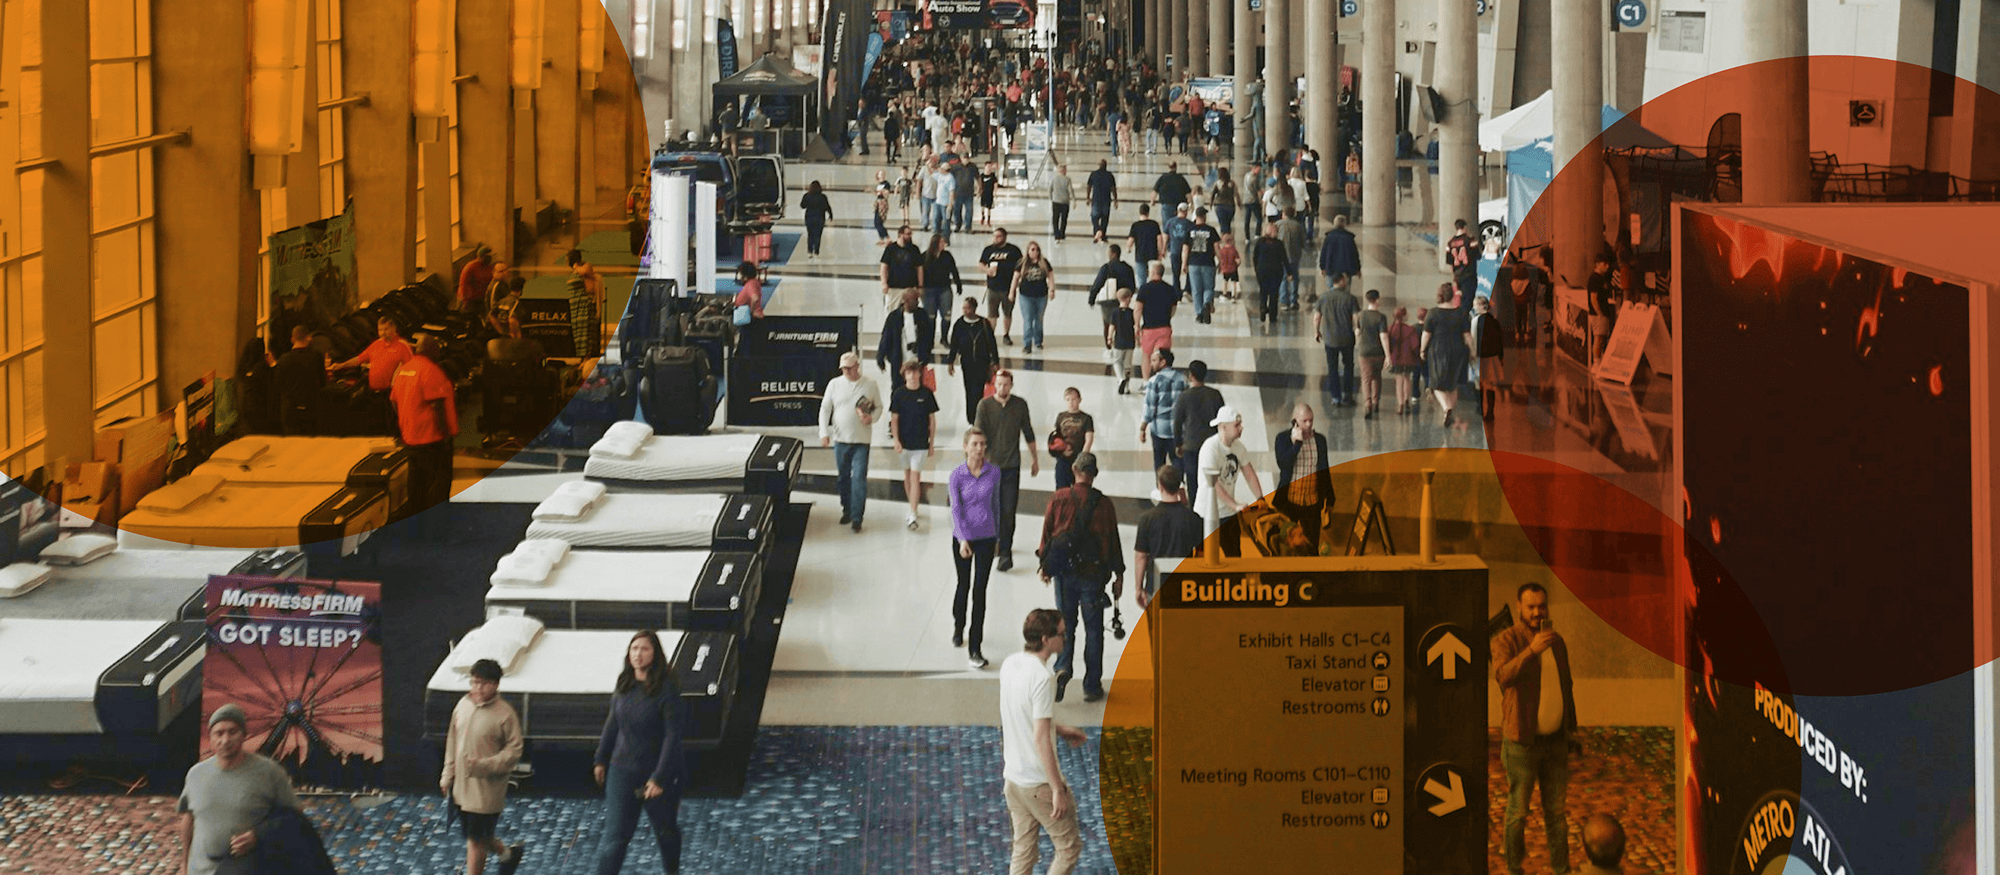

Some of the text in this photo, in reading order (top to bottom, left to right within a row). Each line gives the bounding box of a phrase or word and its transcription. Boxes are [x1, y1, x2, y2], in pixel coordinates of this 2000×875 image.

[928, 0, 981, 13] Auto Show
[1344, 3, 1355, 12] C1
[1477, 0, 1484, 13] 2
[1620, 4, 1640, 21] C1
[832, 11, 846, 63] CHEVROLET
[531, 311, 567, 321] RELAX
[761, 381, 815, 393] RELIEVE
[773, 401, 802, 410] STRESS
[1180, 578, 1289, 607] Building
[219, 623, 363, 649] GOT SLEEP?
[1239, 633, 1293, 648] Exhibit
[1300, 632, 1335, 648] Halls
[1285, 654, 1367, 669] Taxi Stand
[1302, 678, 1366, 692] Elevator
[1282, 701, 1366, 715] Restrooms
[1754, 680, 1868, 804] PRODUCED BY:
[1181, 768, 1247, 787] Meeting
[1253, 768, 1306, 783] Rooms
[1301, 790, 1366, 804] Elevator
[1282, 813, 1366, 828] Restrooms
[1743, 799, 1795, 872] METRO
